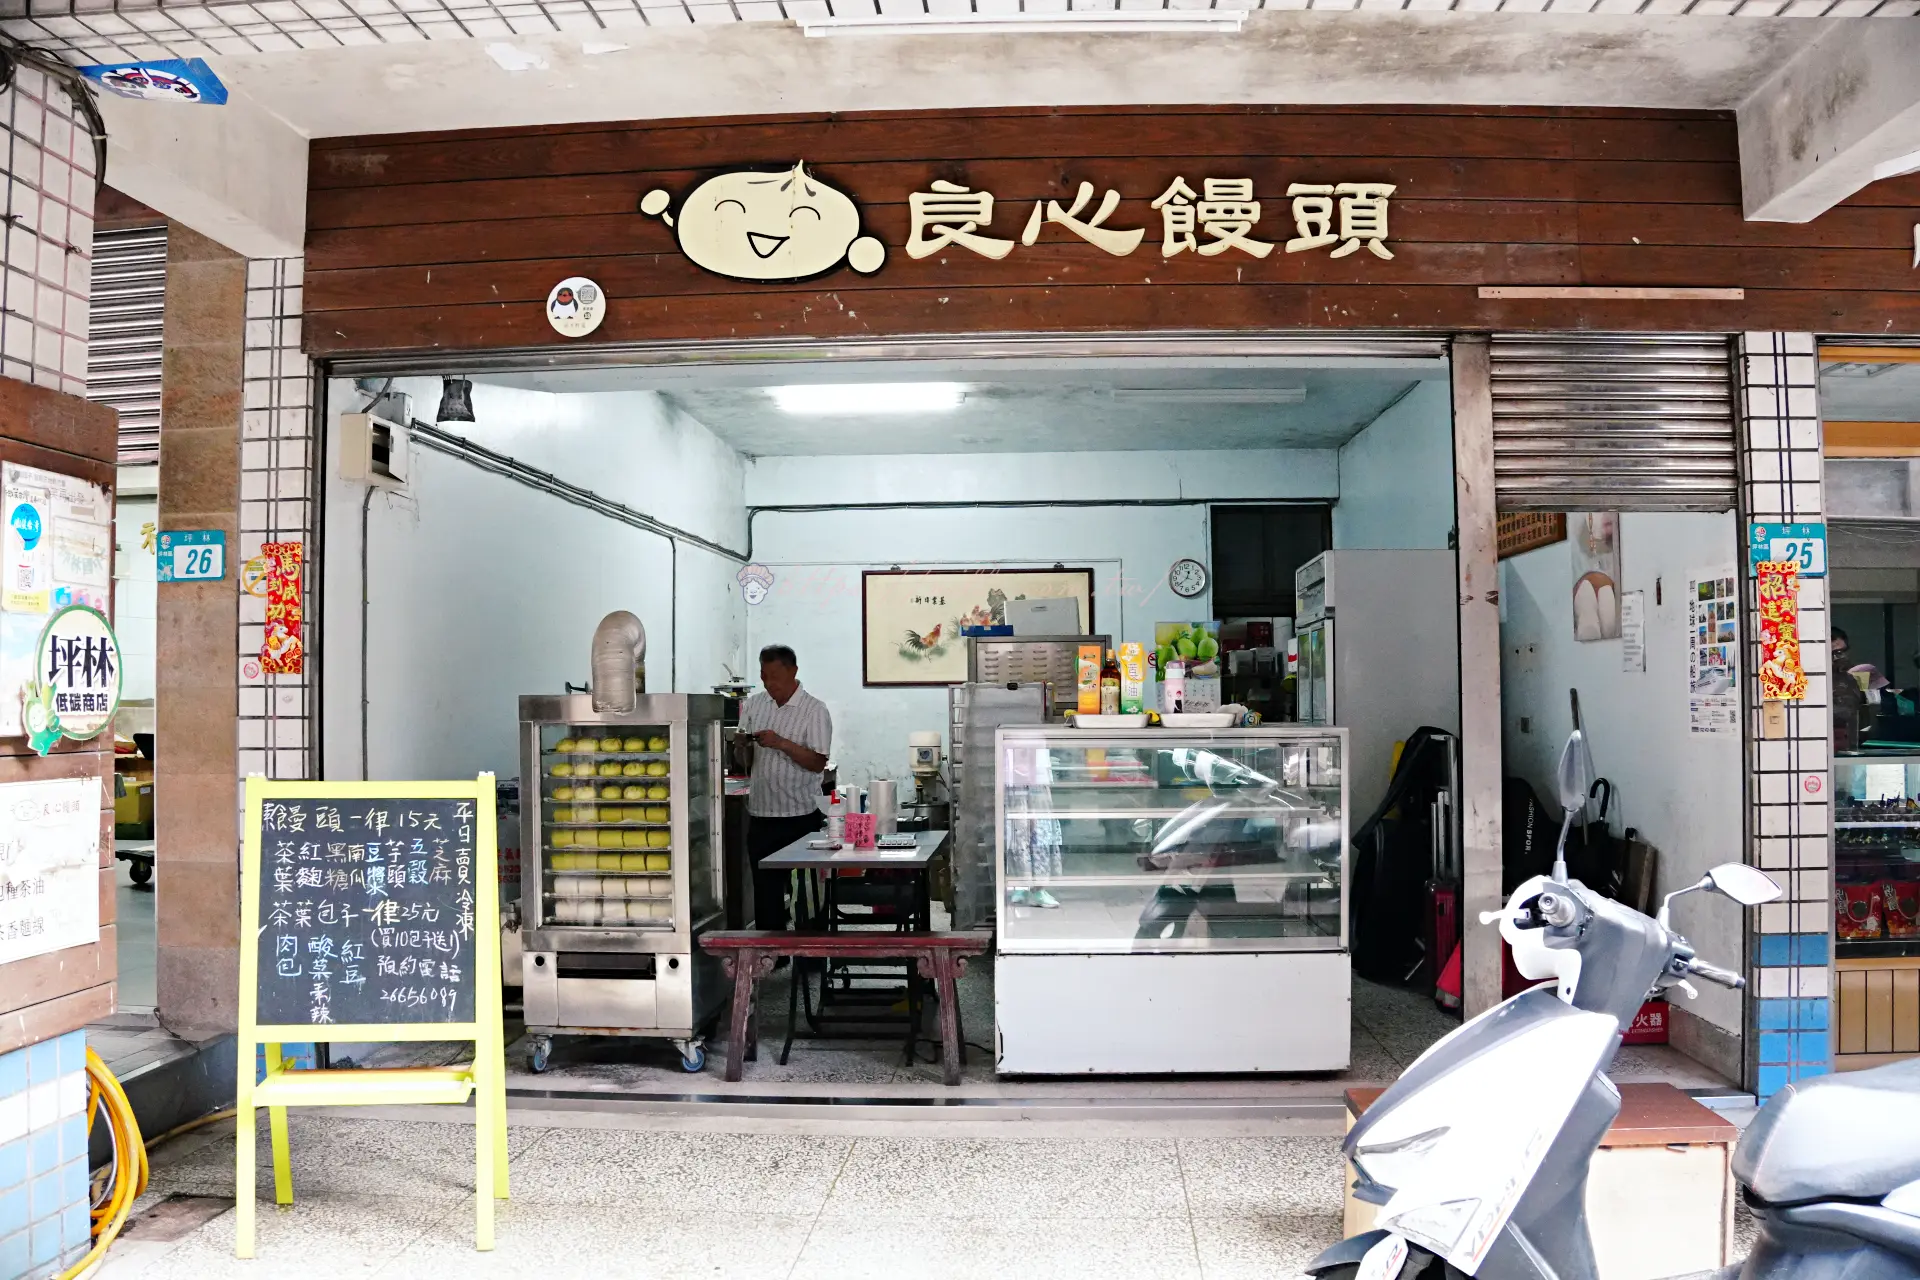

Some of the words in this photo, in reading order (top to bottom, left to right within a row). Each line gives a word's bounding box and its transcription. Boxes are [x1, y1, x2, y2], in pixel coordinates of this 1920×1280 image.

[904, 174, 1398, 260] 良心饅頭
[183, 533, 211, 543] 坪林
[1781, 526, 1811, 536] 坪林
[185, 548, 213, 575] 26
[1785, 541, 1814, 570] 25
[268, 551, 301, 621] 馬到成功
[1760, 573, 1797, 641] 招財進寶
[48, 634, 115, 689] 坪林
[55, 692, 109, 713] 低碳商店
[274, 840, 295, 893] 茶葉
[324, 842, 348, 891] 黑糖
[348, 844, 366, 888] 南瓜
[365, 842, 388, 897] 豆漿
[387, 839, 406, 889] 芋頭
[407, 838, 428, 885] 五穀
[454, 802, 474, 941] 平日賣冷凍
[275, 935, 302, 977] 肉包
[340, 940, 367, 983] 紅豆
[376, 955, 462, 983] 預約電話
[379, 989, 458, 1012] 26656089
[1631, 1012, 1662, 1028] 火器
